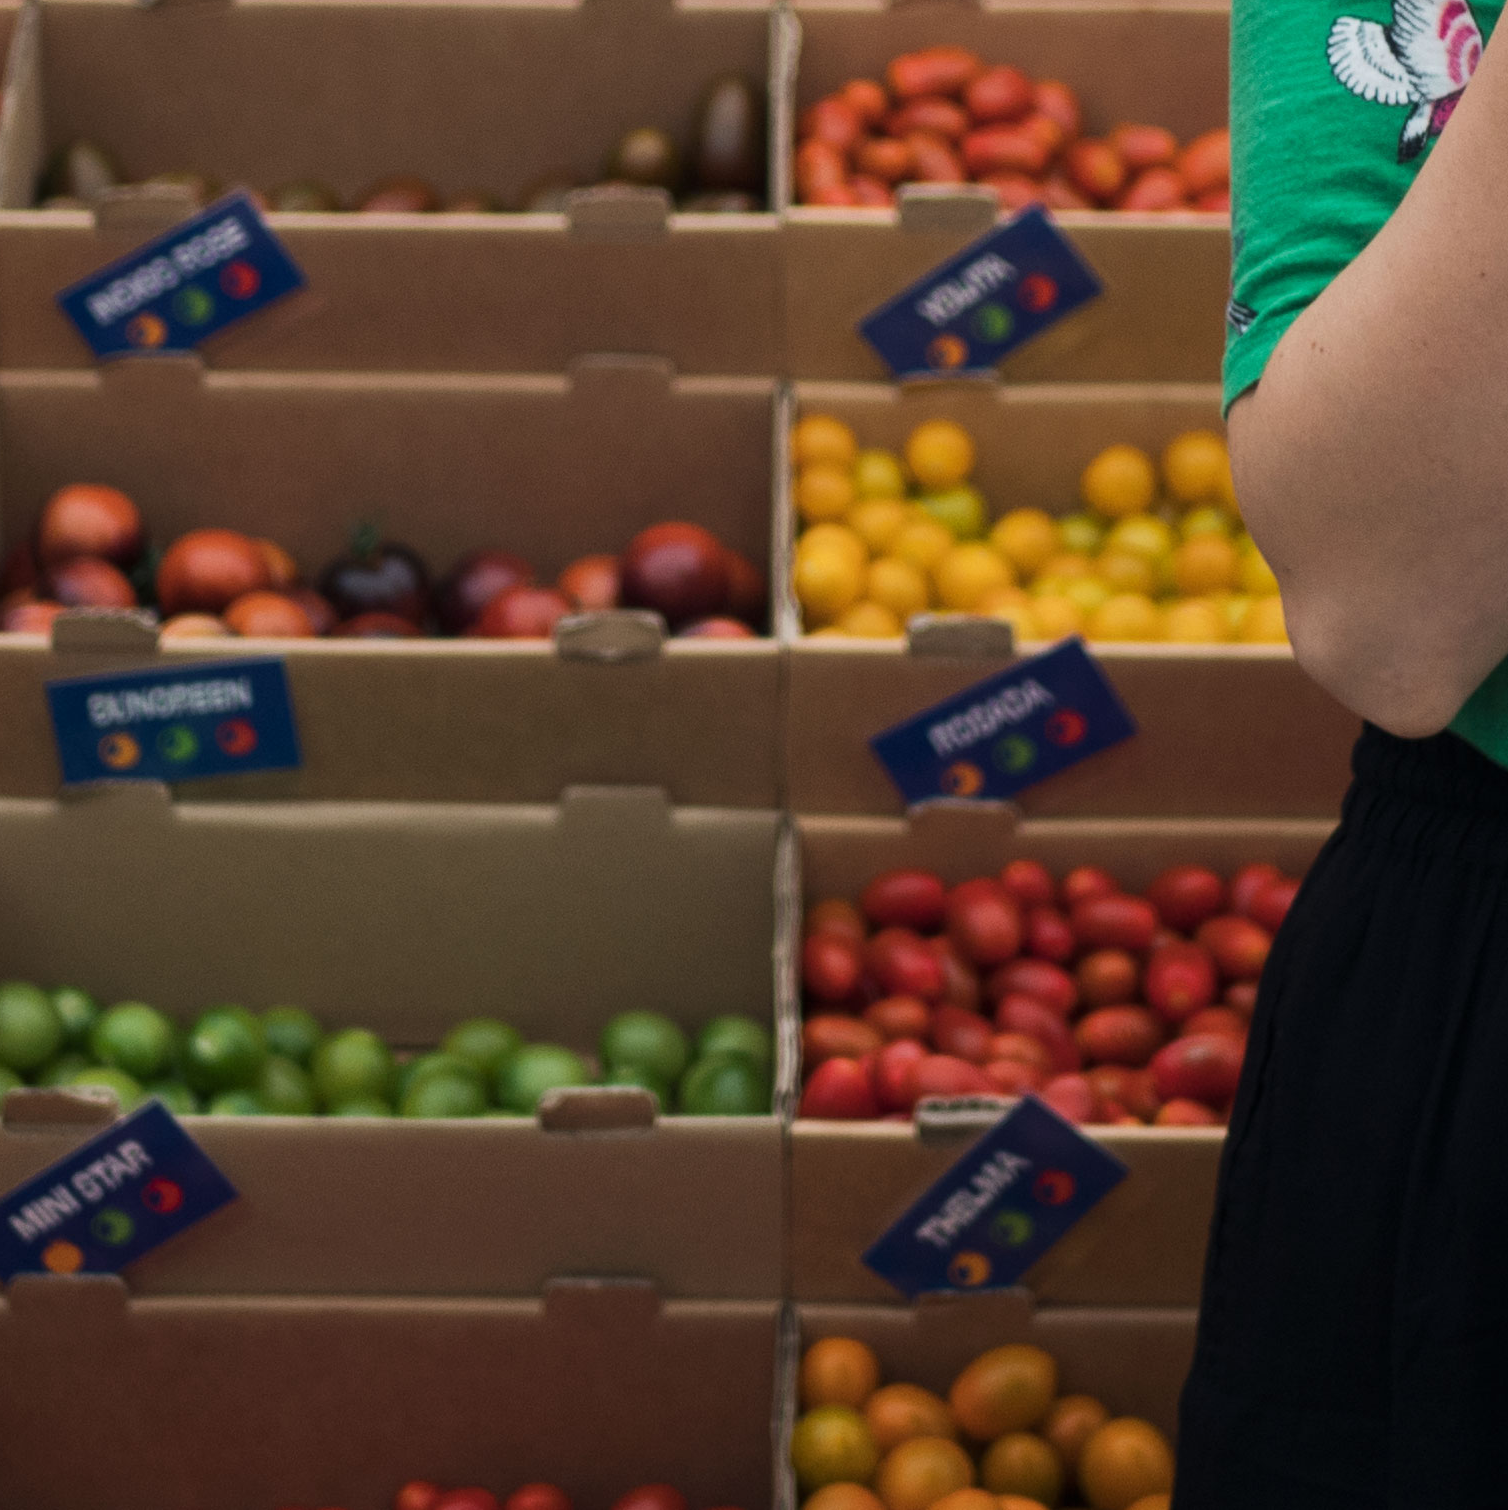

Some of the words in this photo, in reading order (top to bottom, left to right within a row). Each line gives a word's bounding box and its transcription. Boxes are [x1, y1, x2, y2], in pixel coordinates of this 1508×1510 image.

[11, 1186, 80, 1238] MINI
[73, 1140, 149, 1200] STAR
[917, 1152, 1026, 1244] THELMA
